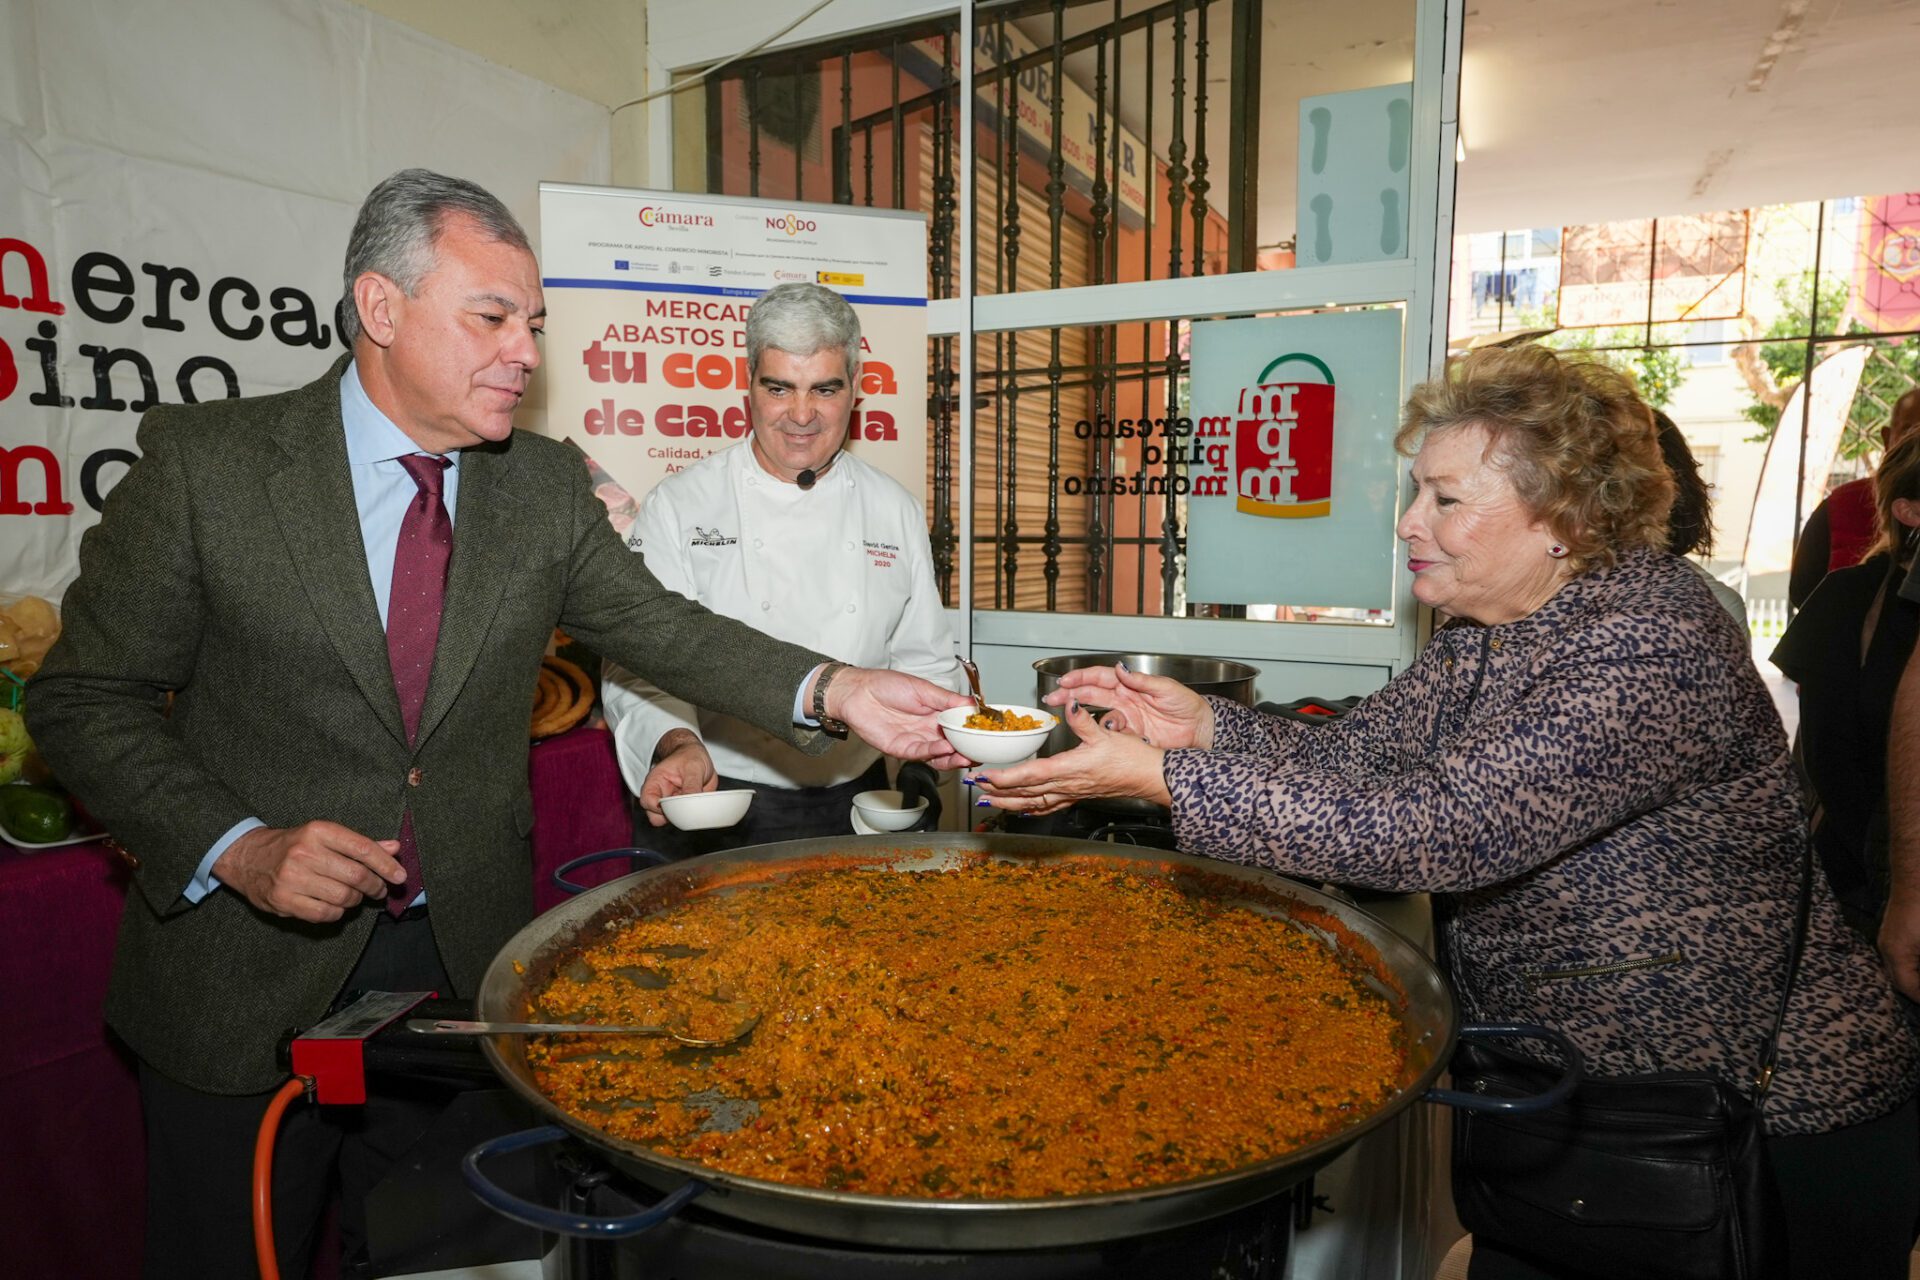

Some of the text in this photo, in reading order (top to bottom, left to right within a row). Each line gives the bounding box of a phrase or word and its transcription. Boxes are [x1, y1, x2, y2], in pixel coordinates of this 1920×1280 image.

[639, 206, 714, 228] Cámara
[0, 238, 352, 351] merca
[646, 299, 752, 322] MERCAD
[603, 324, 747, 348] ABASTOS D
[583, 340, 647, 384] tu
[584, 395, 898, 441] de cad ía
[647, 447, 704, 460] Calidad,
[691, 538, 737, 547] MICHELIN
[867, 549, 896, 559] MICHELIN
